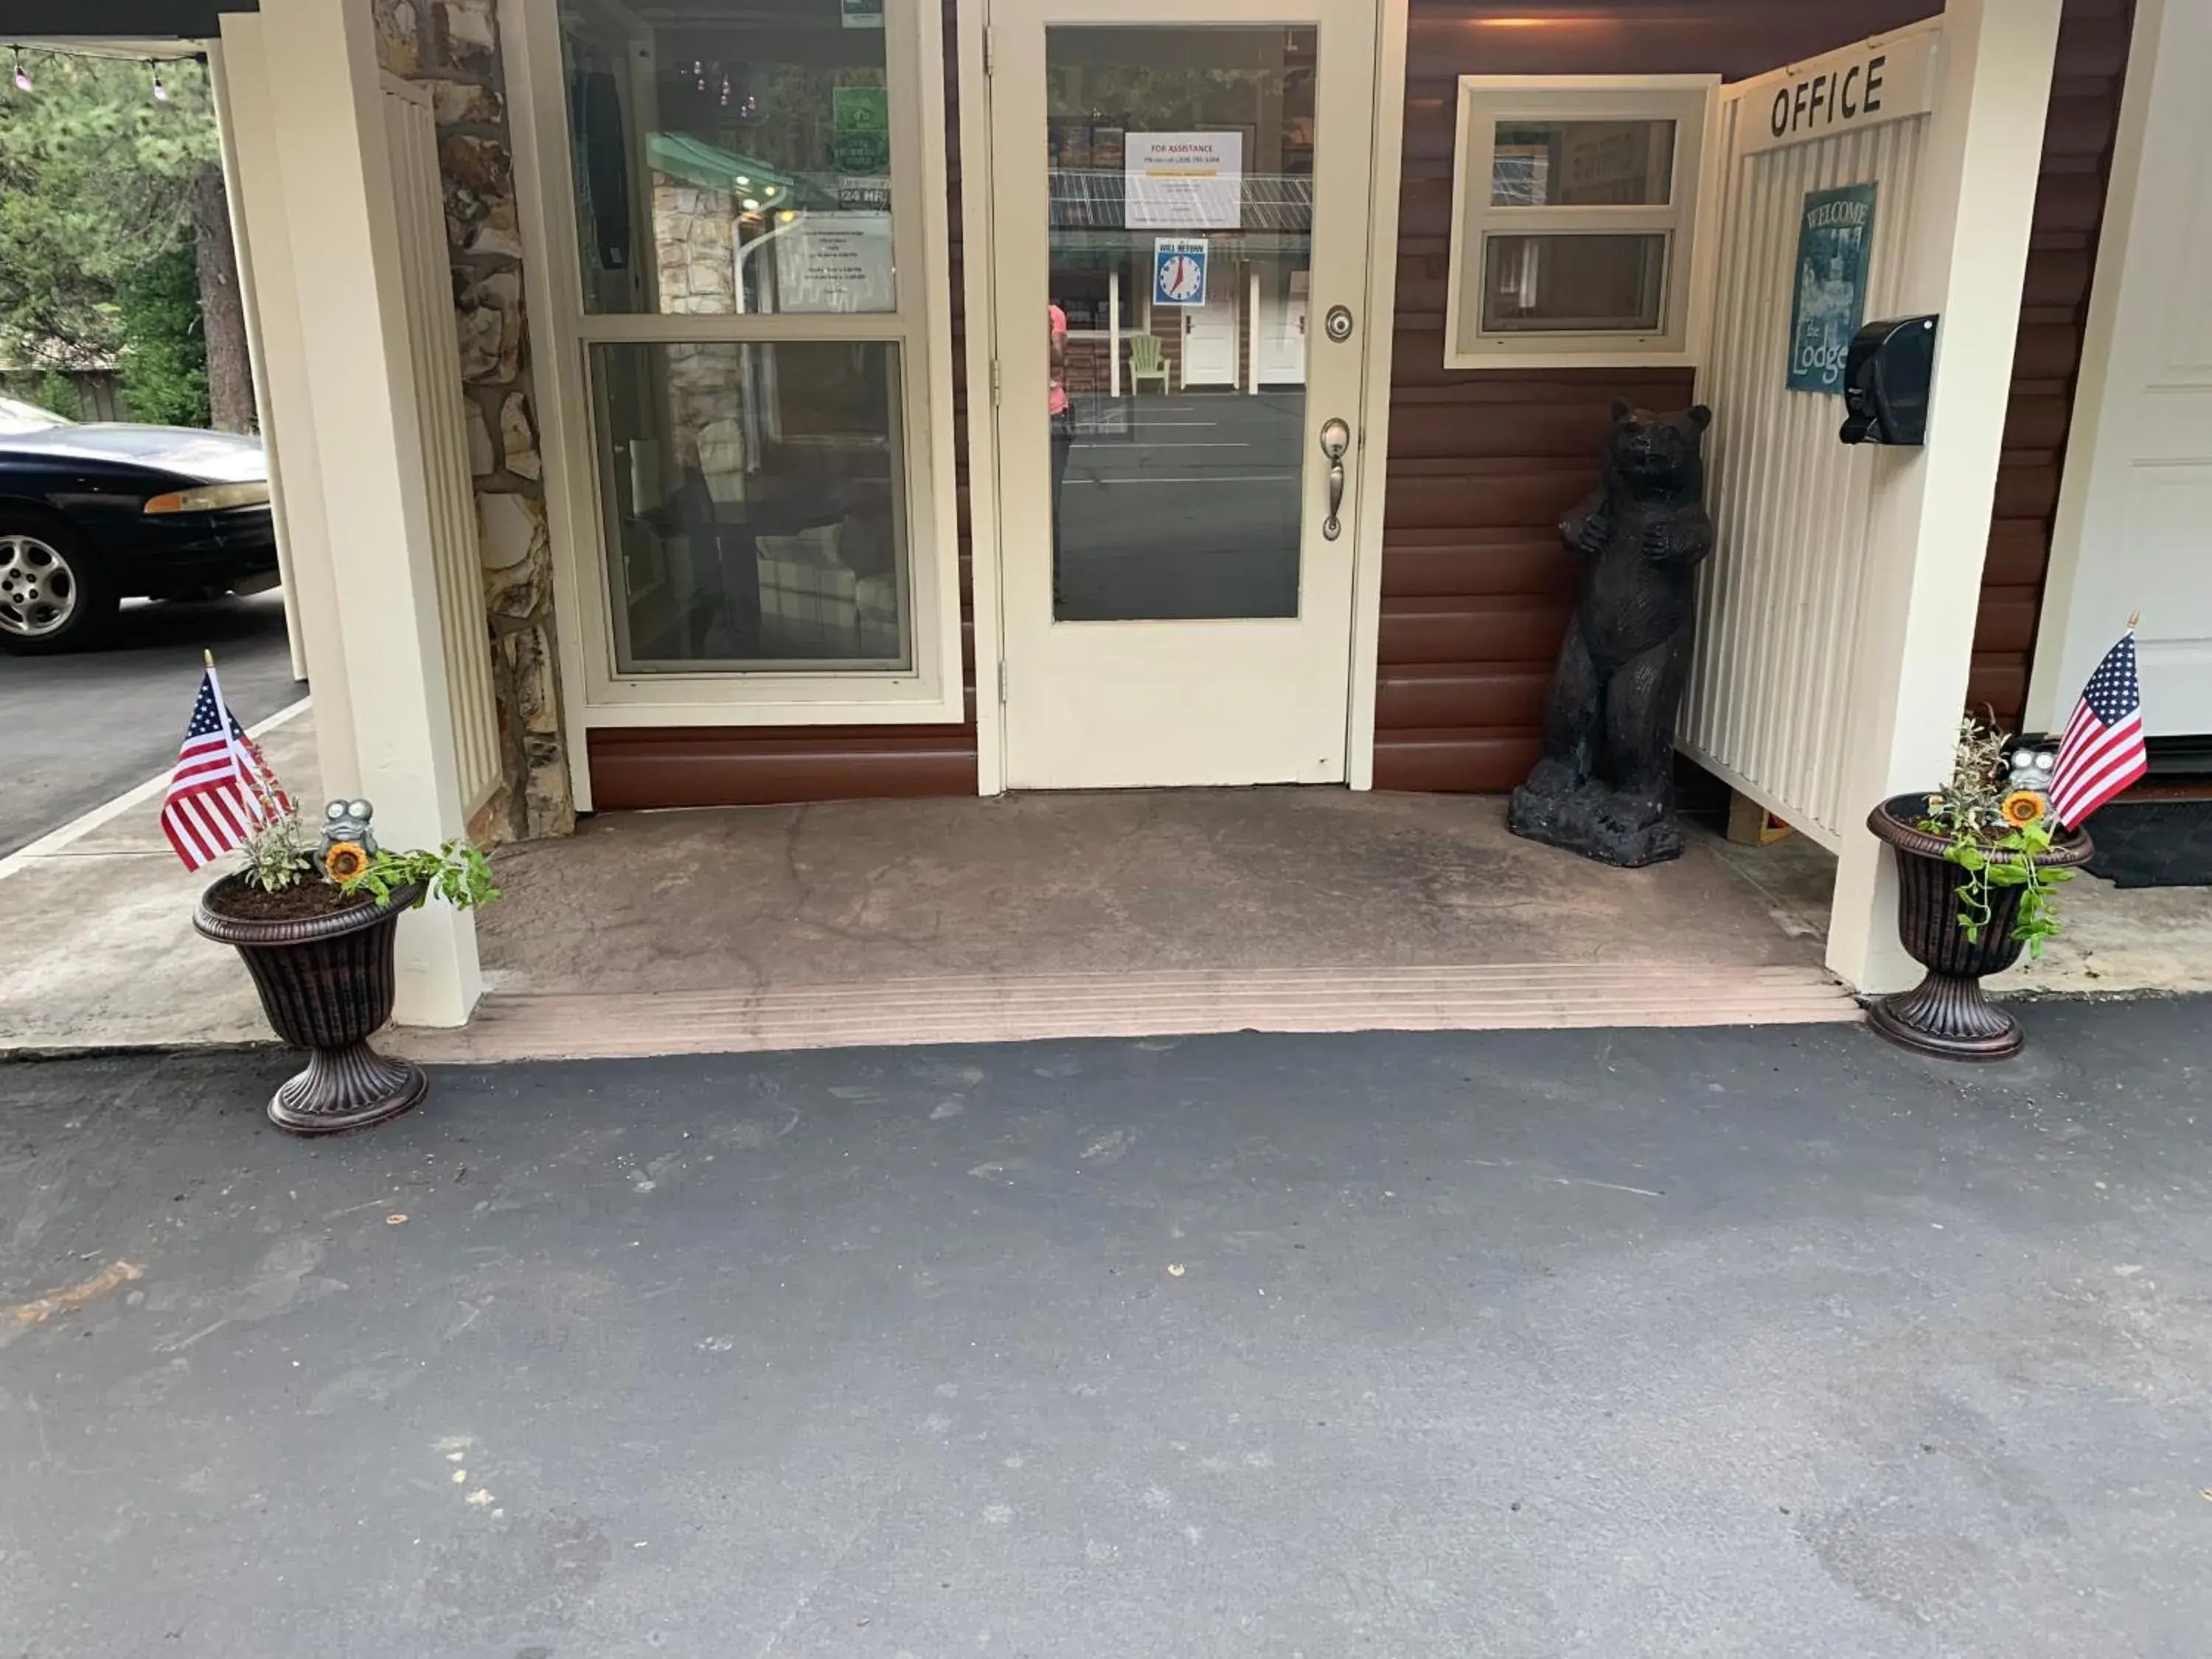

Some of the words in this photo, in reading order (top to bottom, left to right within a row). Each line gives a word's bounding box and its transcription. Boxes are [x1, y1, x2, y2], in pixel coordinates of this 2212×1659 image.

[1771, 55, 1886, 137] OFFICE
[1151, 145, 1167, 153] FOR
[1169, 145, 1213, 153] ASSISTANCE
[1806, 201, 1868, 229] WELCOME
[1160, 244, 1175, 252] WILL
[1178, 244, 1204, 253] RETURN
[1806, 319, 1820, 338] the
[1792, 322, 1850, 384] Lodge
